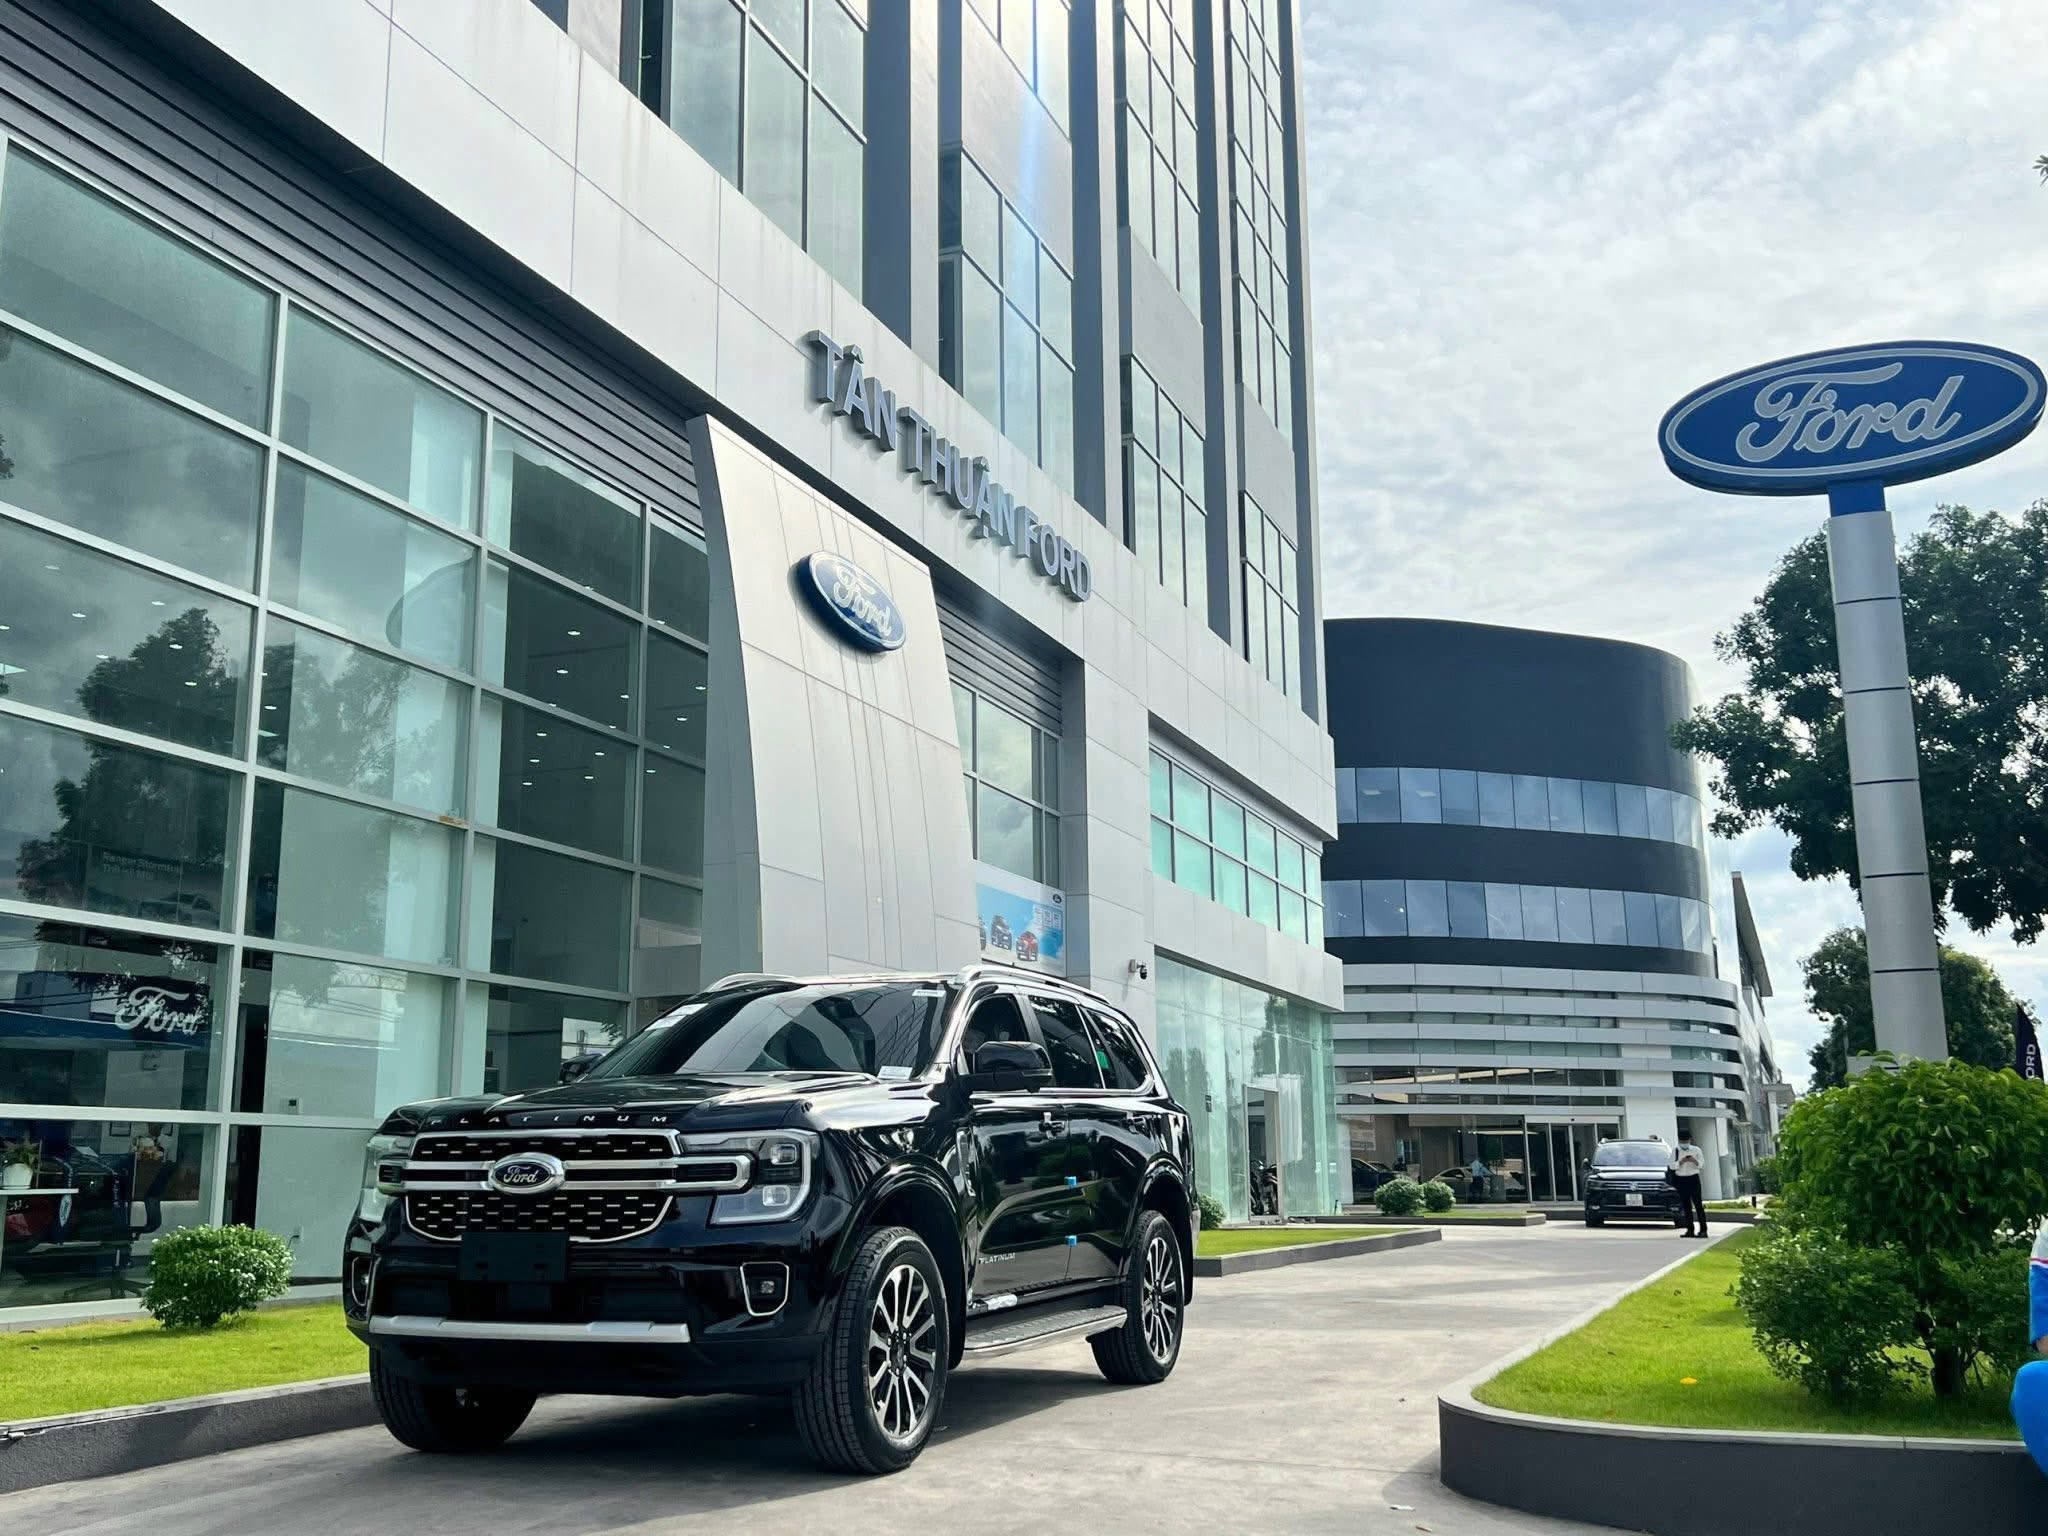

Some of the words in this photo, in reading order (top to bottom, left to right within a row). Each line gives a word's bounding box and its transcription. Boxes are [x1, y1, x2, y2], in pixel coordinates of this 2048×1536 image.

[1735, 361, 1965, 463] Ford
[803, 329, 896, 452] TÂN
[897, 406, 1015, 547] THUẬN
[1016, 505, 1091, 602] FORD
[833, 565, 892, 637] Ford
[115, 986, 203, 1035] Ford
[430, 1115, 668, 1126] PLATINUM
[503, 1165, 539, 1183] Ford
[979, 1252, 1016, 1264] PLATINUM
